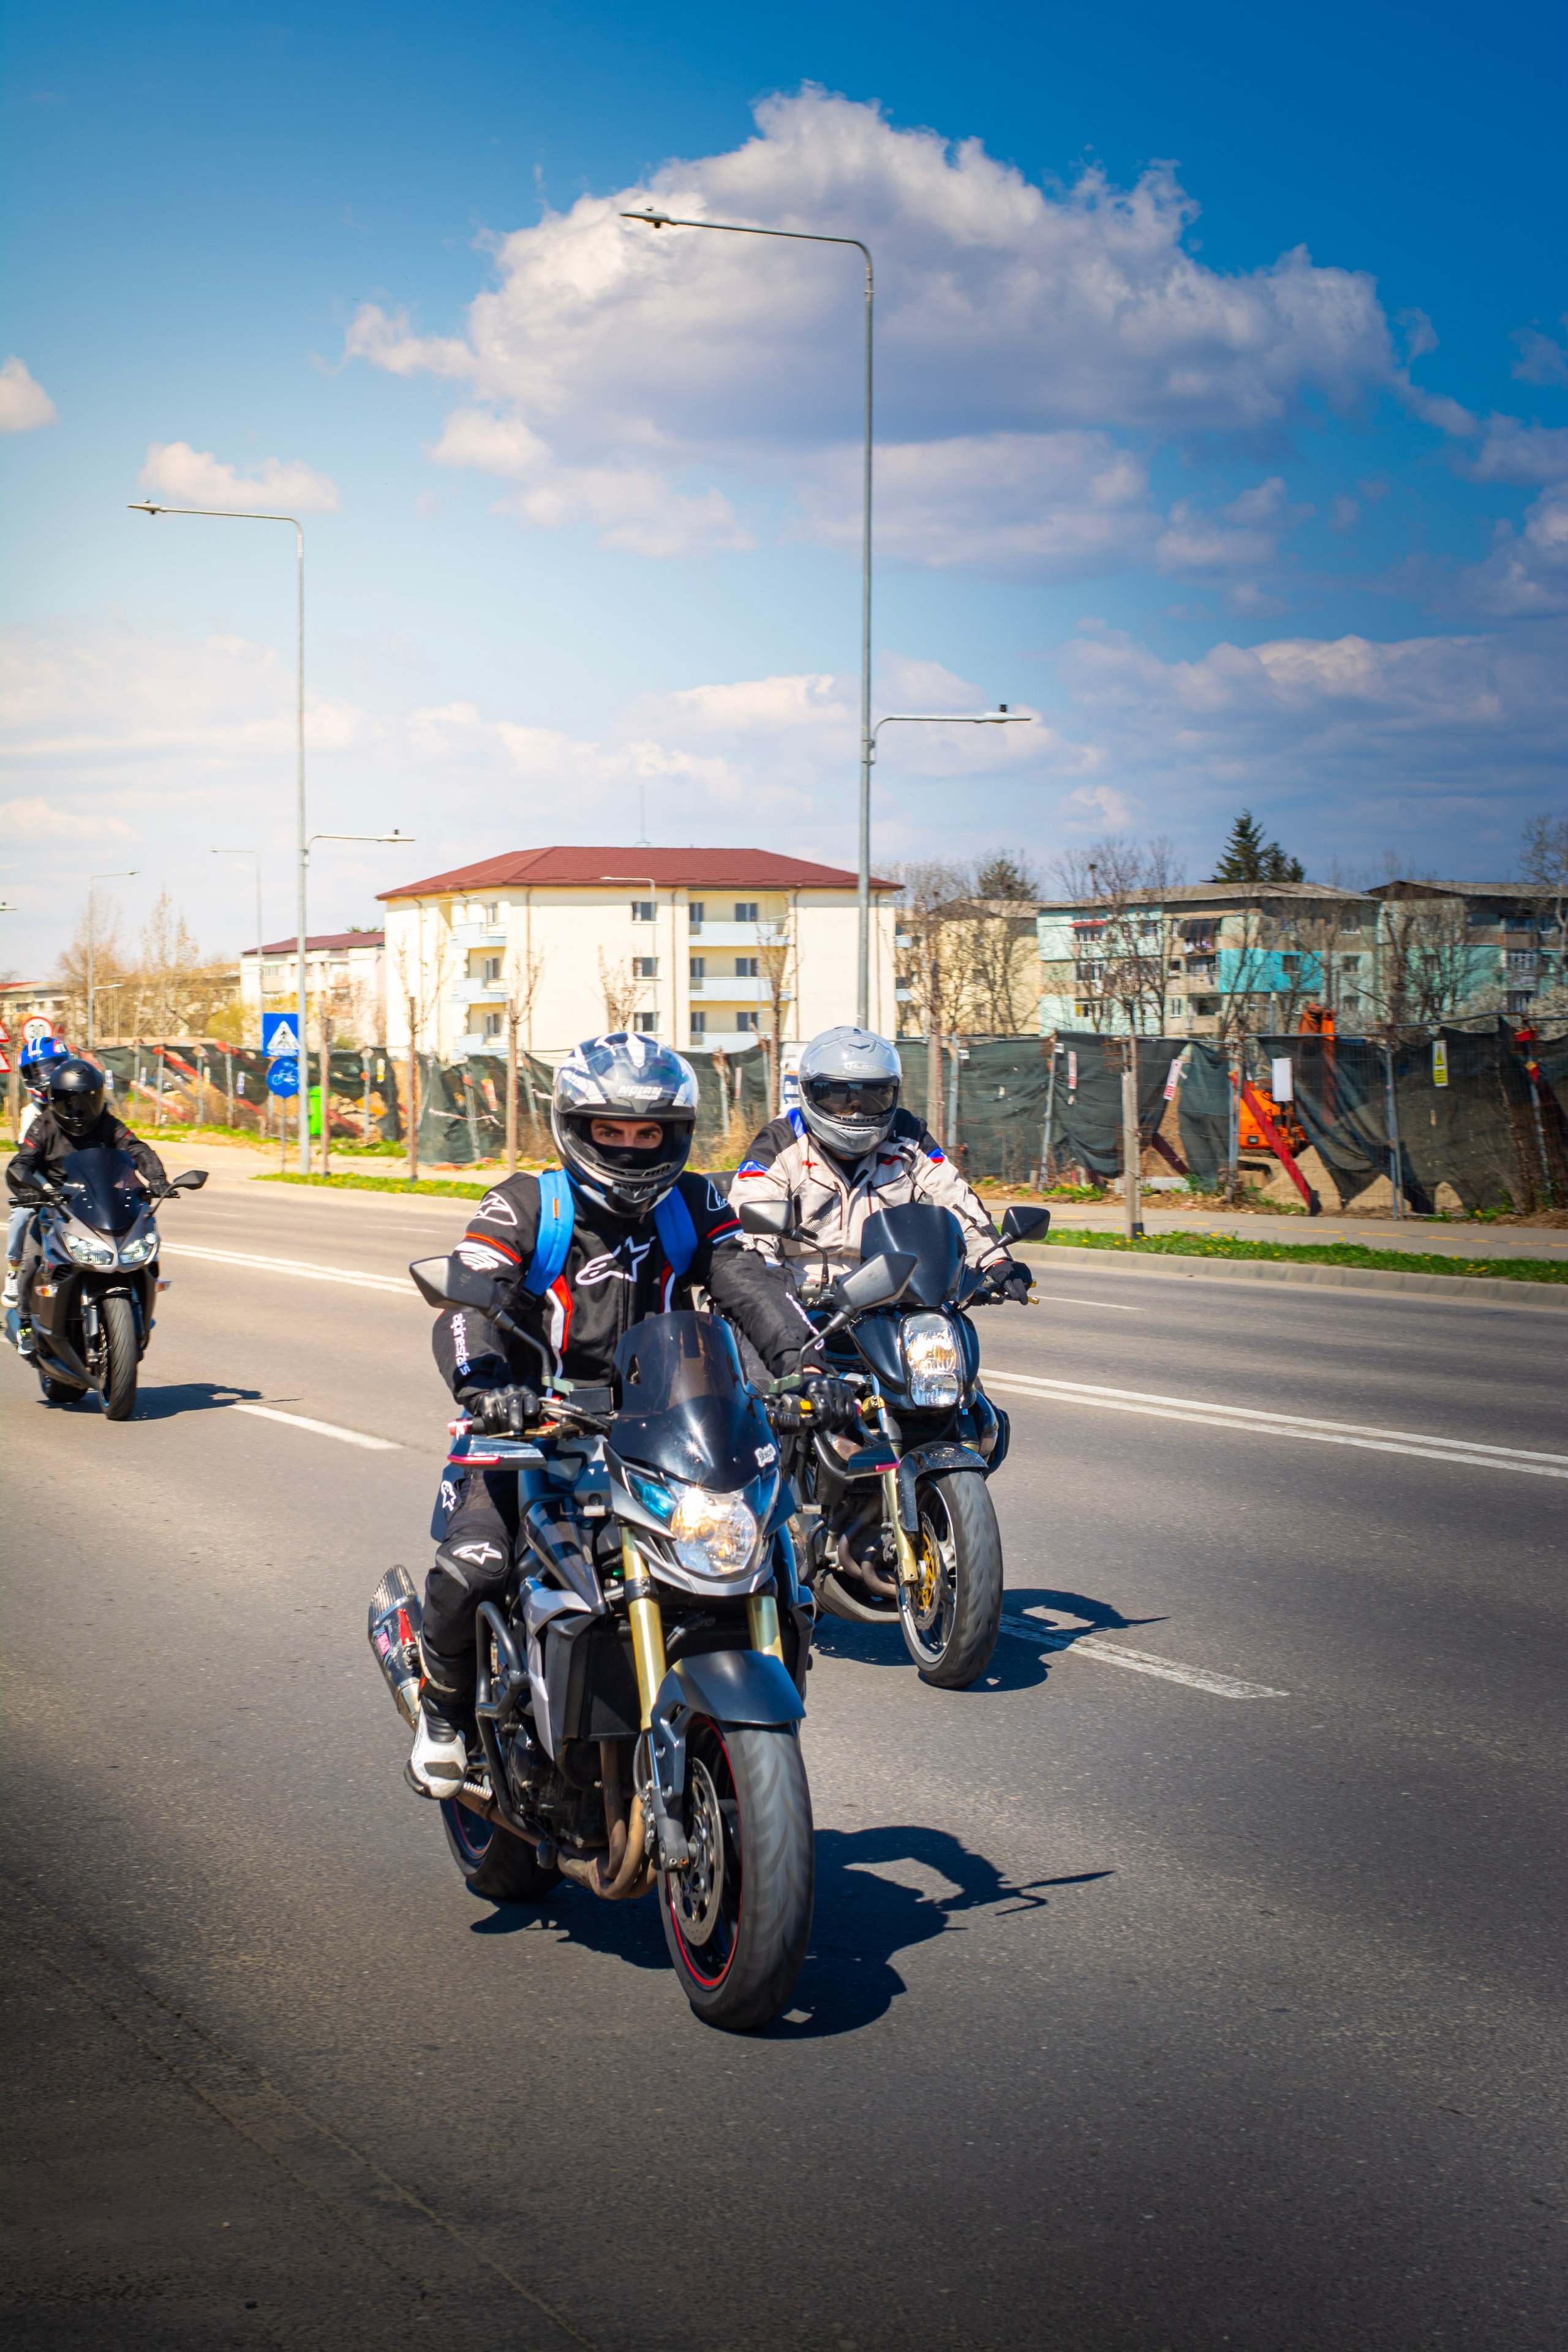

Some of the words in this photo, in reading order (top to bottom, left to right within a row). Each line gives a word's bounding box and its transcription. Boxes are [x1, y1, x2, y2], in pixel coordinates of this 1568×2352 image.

[31, 1024, 46, 1038] 30
[617, 1085, 663, 1100] NOLAN
[450, 1313, 471, 1376] alpinestars
